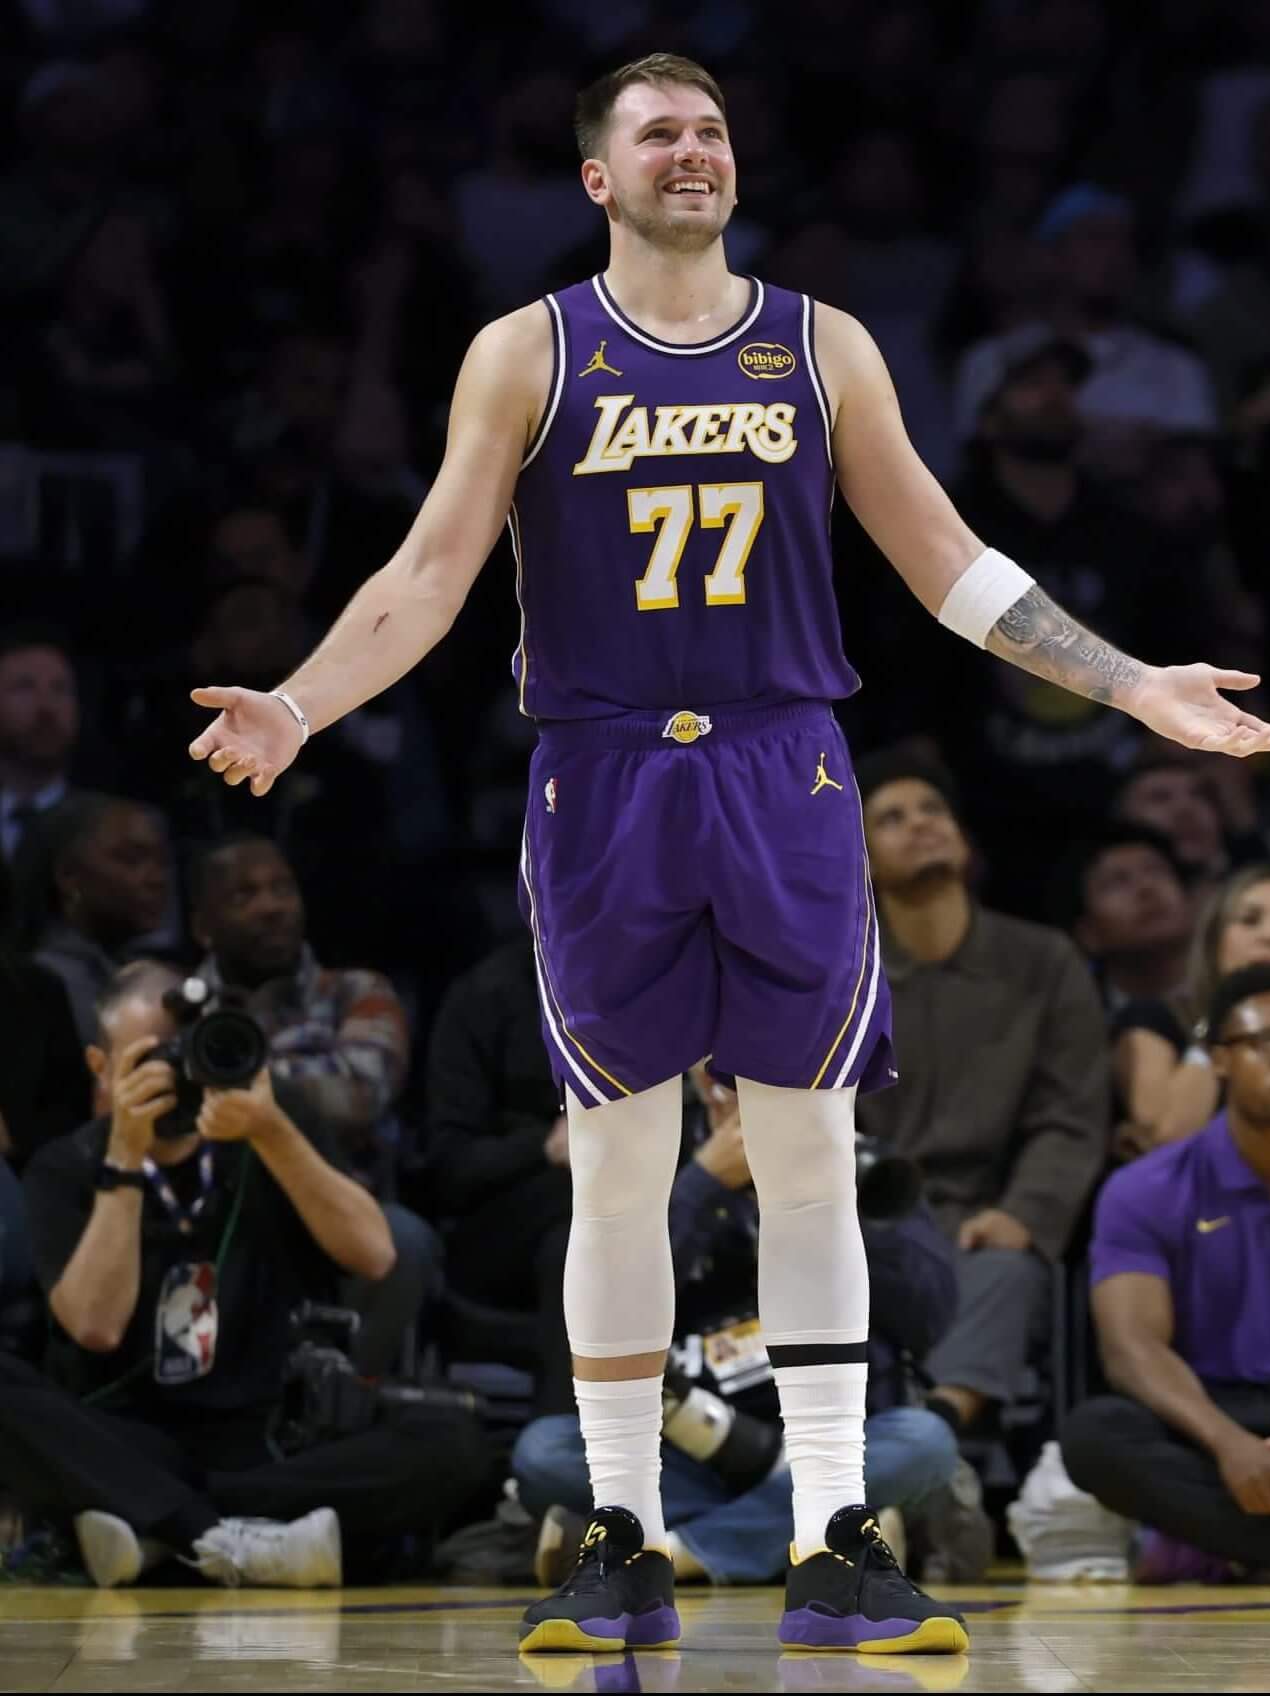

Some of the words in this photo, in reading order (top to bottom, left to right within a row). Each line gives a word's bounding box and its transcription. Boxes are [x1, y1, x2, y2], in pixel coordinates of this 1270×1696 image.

[743, 352, 791, 368] bibigo
[573, 394, 798, 475] LAKERS
[627, 481, 764, 611] 77
